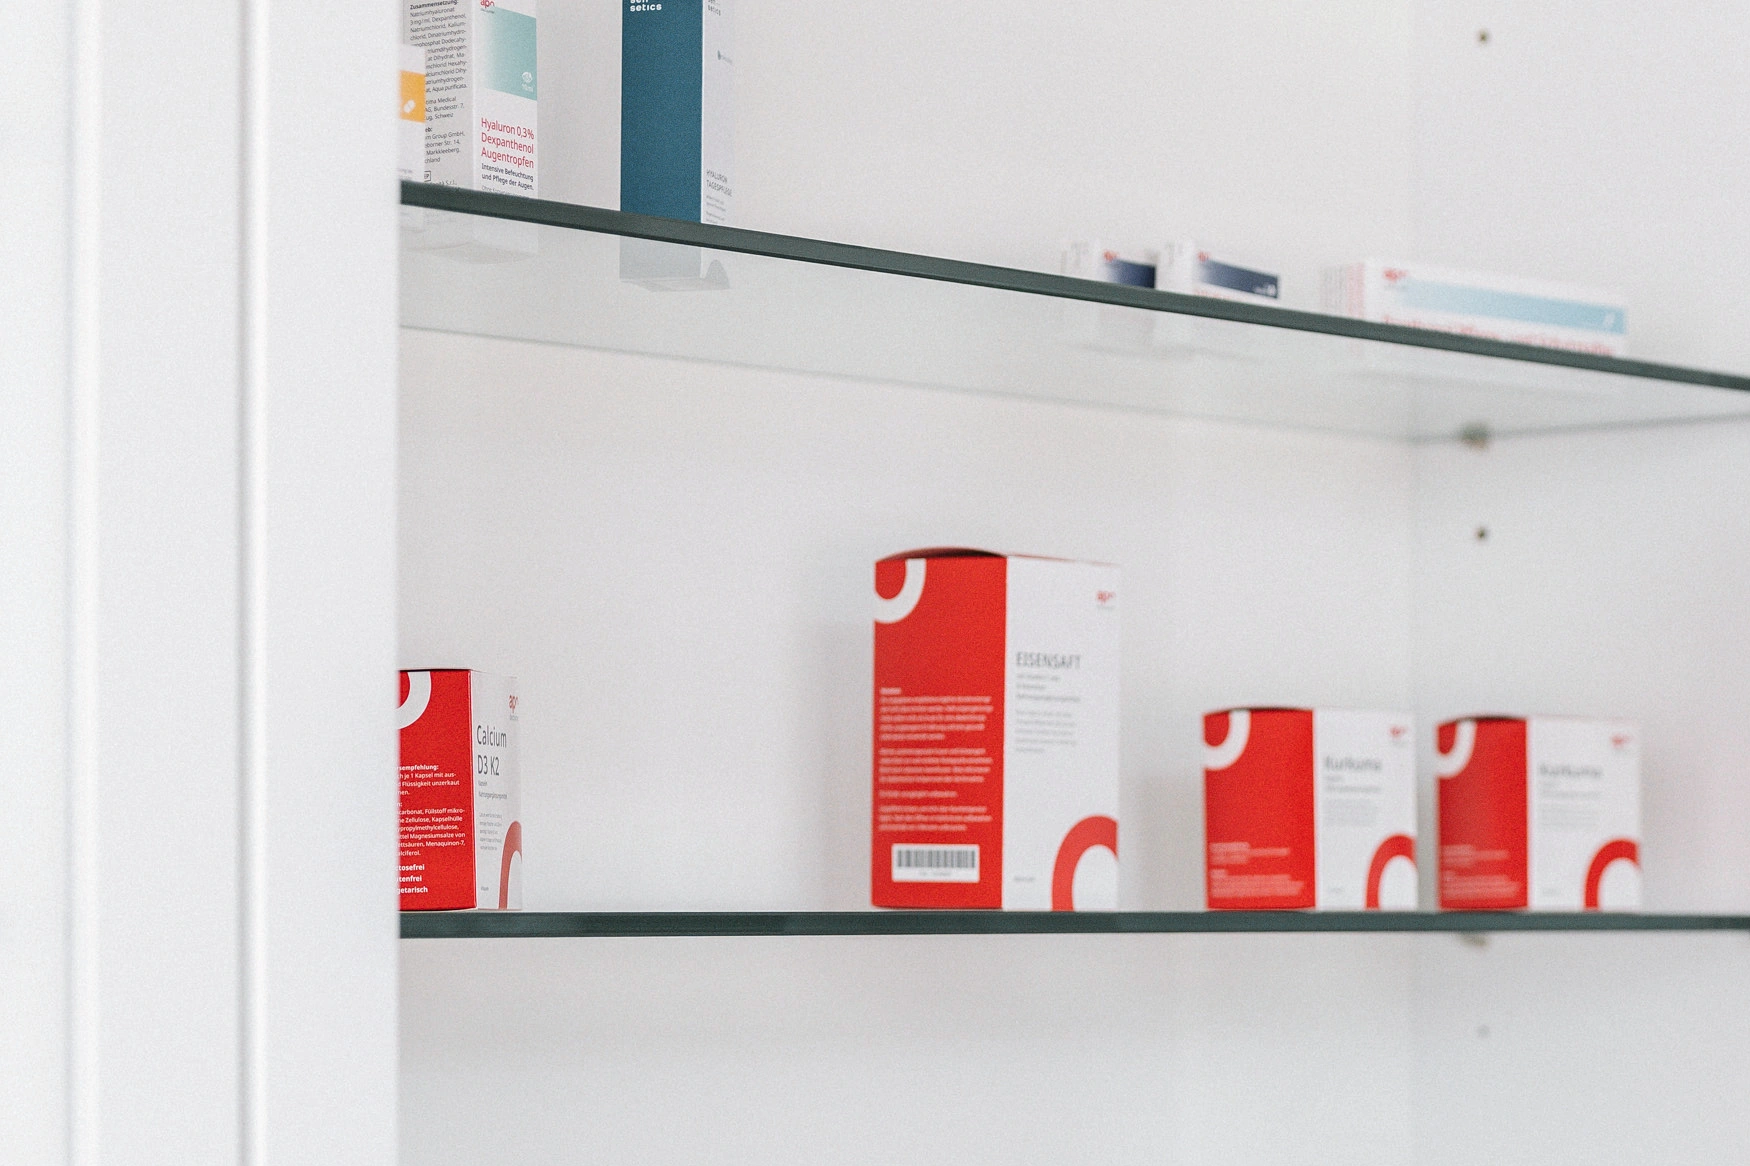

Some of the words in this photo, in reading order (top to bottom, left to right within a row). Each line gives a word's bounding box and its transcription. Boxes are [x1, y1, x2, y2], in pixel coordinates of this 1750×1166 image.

[481, 117, 516, 135] Hyaluron
[517, 126, 535, 140] 0,3%
[481, 132, 534, 154] Dexpanthenol
[481, 147, 534, 168] Augentropfen
[482, 163, 504, 174] Intensive
[505, 168, 534, 182] Befeuchtung
[482, 173, 492, 181] und
[493, 175, 508, 185] Pflege
[477, 724, 507, 748] Calcium
[477, 754, 488, 775] D3
[490, 756, 500, 776] K2
